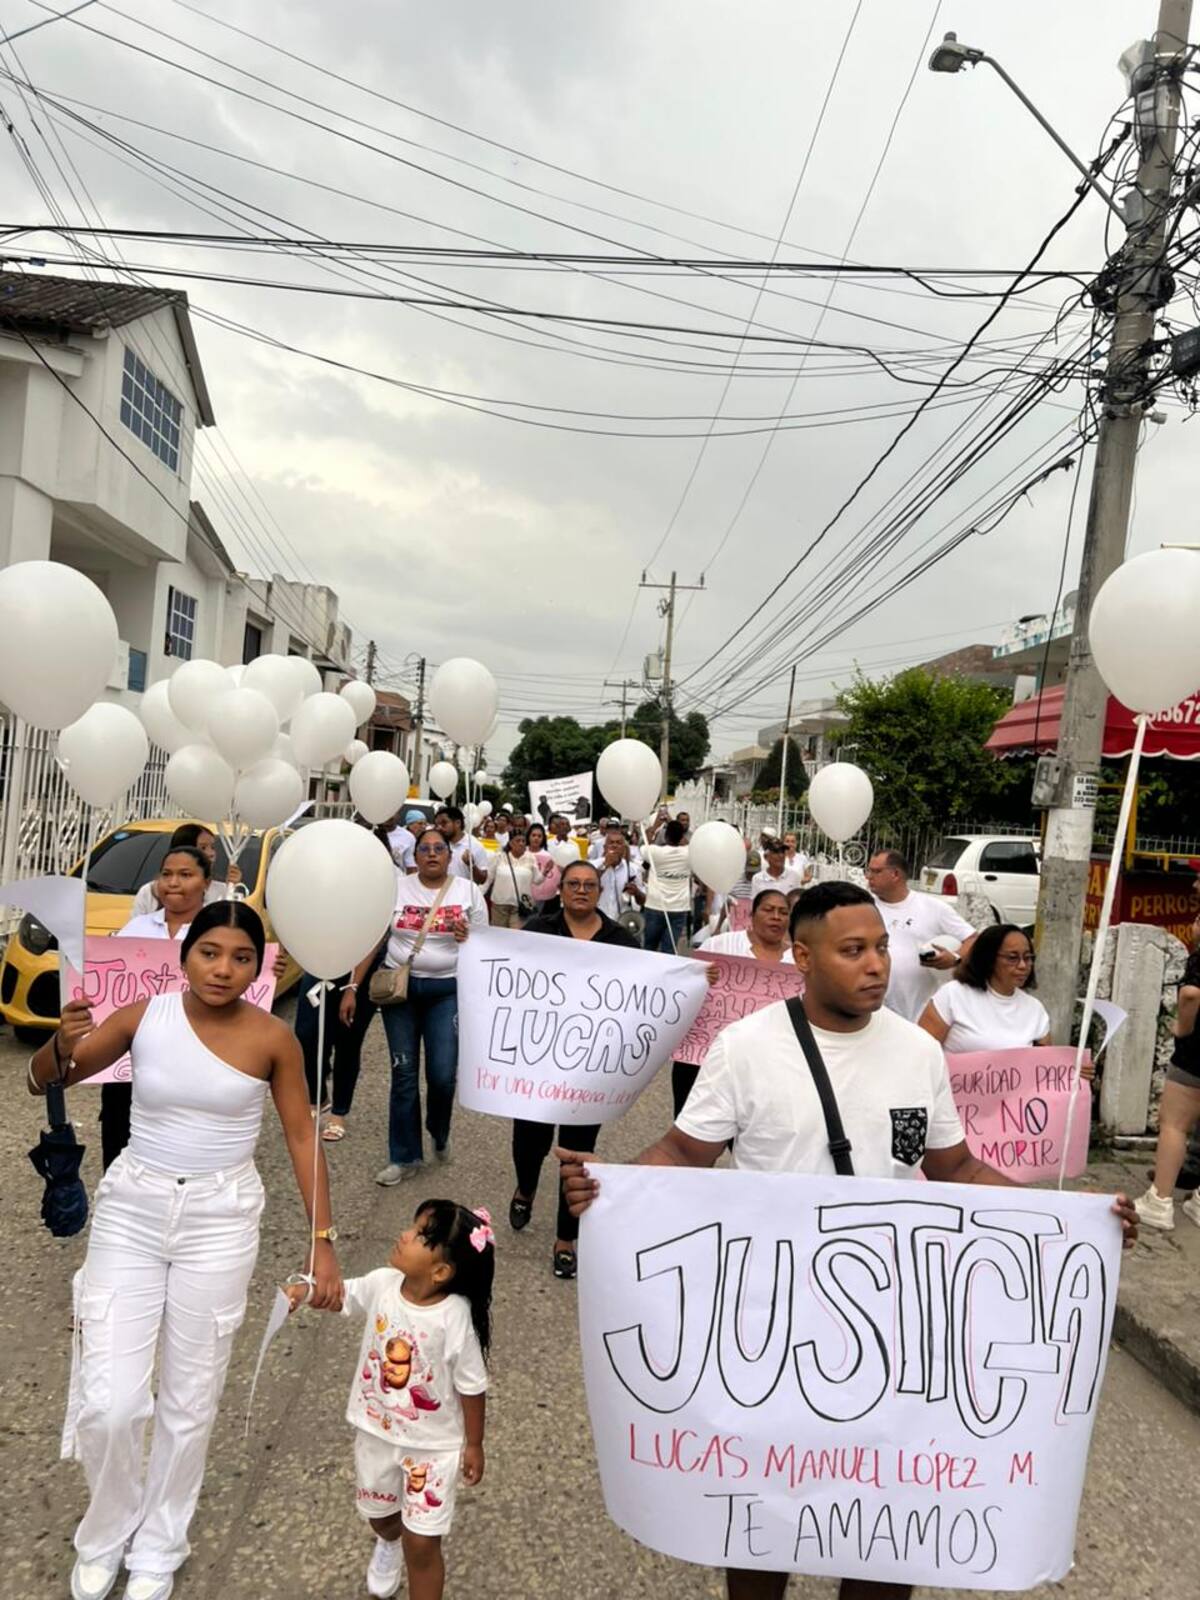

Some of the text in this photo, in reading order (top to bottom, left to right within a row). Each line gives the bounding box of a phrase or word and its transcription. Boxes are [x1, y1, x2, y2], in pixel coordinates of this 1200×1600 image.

[480, 958, 688, 1024] TODOS SOMOS
[708, 958, 806, 1000] QUERE
[489, 1007, 657, 1076] LUCAS
[1001, 1096, 1049, 1136] NO
[980, 1138, 1060, 1168] MORIR
[604, 1200, 1107, 1438] JUSTICIA
[629, 1423, 749, 1479] LUCAS
[898, 1438, 985, 1491] LÓPEZ
[1009, 1451, 1041, 1487] M.
[703, 1492, 1003, 1574] TE AMAMOS
